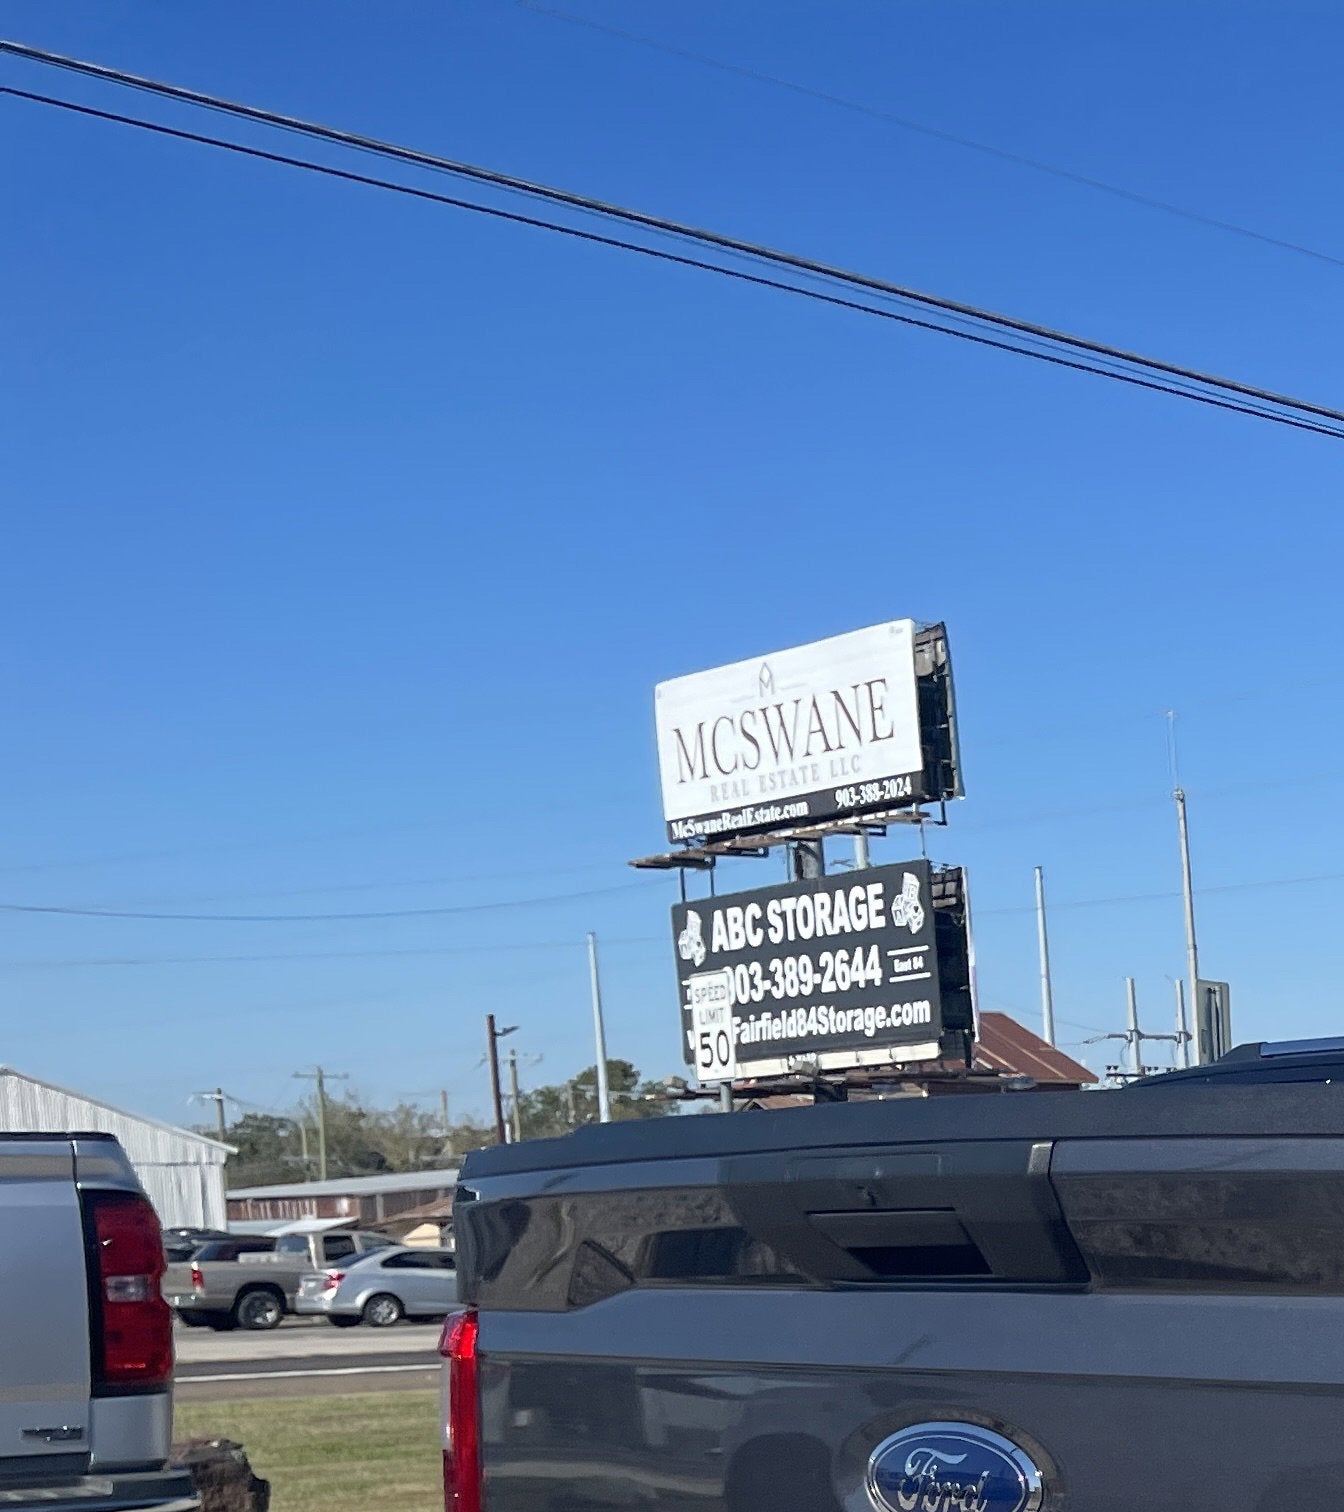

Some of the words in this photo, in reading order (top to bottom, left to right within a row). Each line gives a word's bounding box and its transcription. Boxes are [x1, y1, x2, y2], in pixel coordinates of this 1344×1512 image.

[673, 678, 895, 783] MCSWANE
[710, 779, 750, 802] REAL
[758, 763, 820, 794] ESTATE
[829, 754, 861, 778] LLC
[671, 800, 810, 840] McSwaneRealEstate.com
[711, 902, 764, 953] ABC
[767, 883, 887, 944] STORAGE
[694, 984, 727, 1004] SPEED
[700, 1030, 730, 1068] 50
